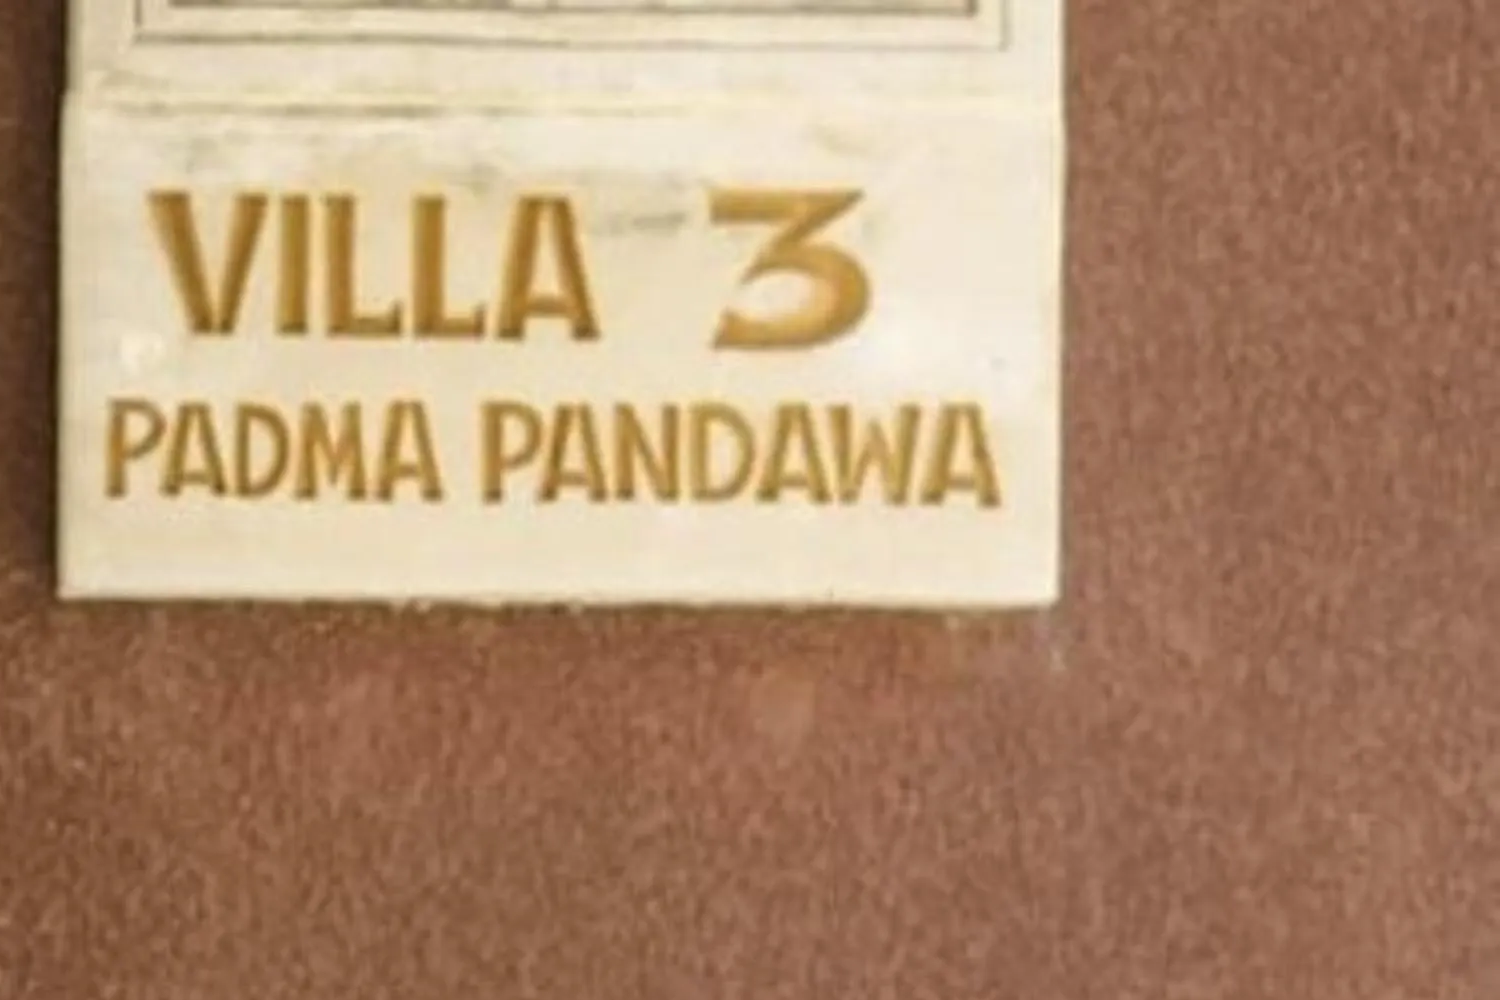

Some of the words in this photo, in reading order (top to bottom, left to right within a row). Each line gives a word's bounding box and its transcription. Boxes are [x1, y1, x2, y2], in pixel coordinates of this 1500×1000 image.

[149, 189, 600, 341] VILLA
[709, 189, 871, 350] 3
[105, 400, 444, 503] PADMA
[480, 402, 1001, 506] PANDAWA
